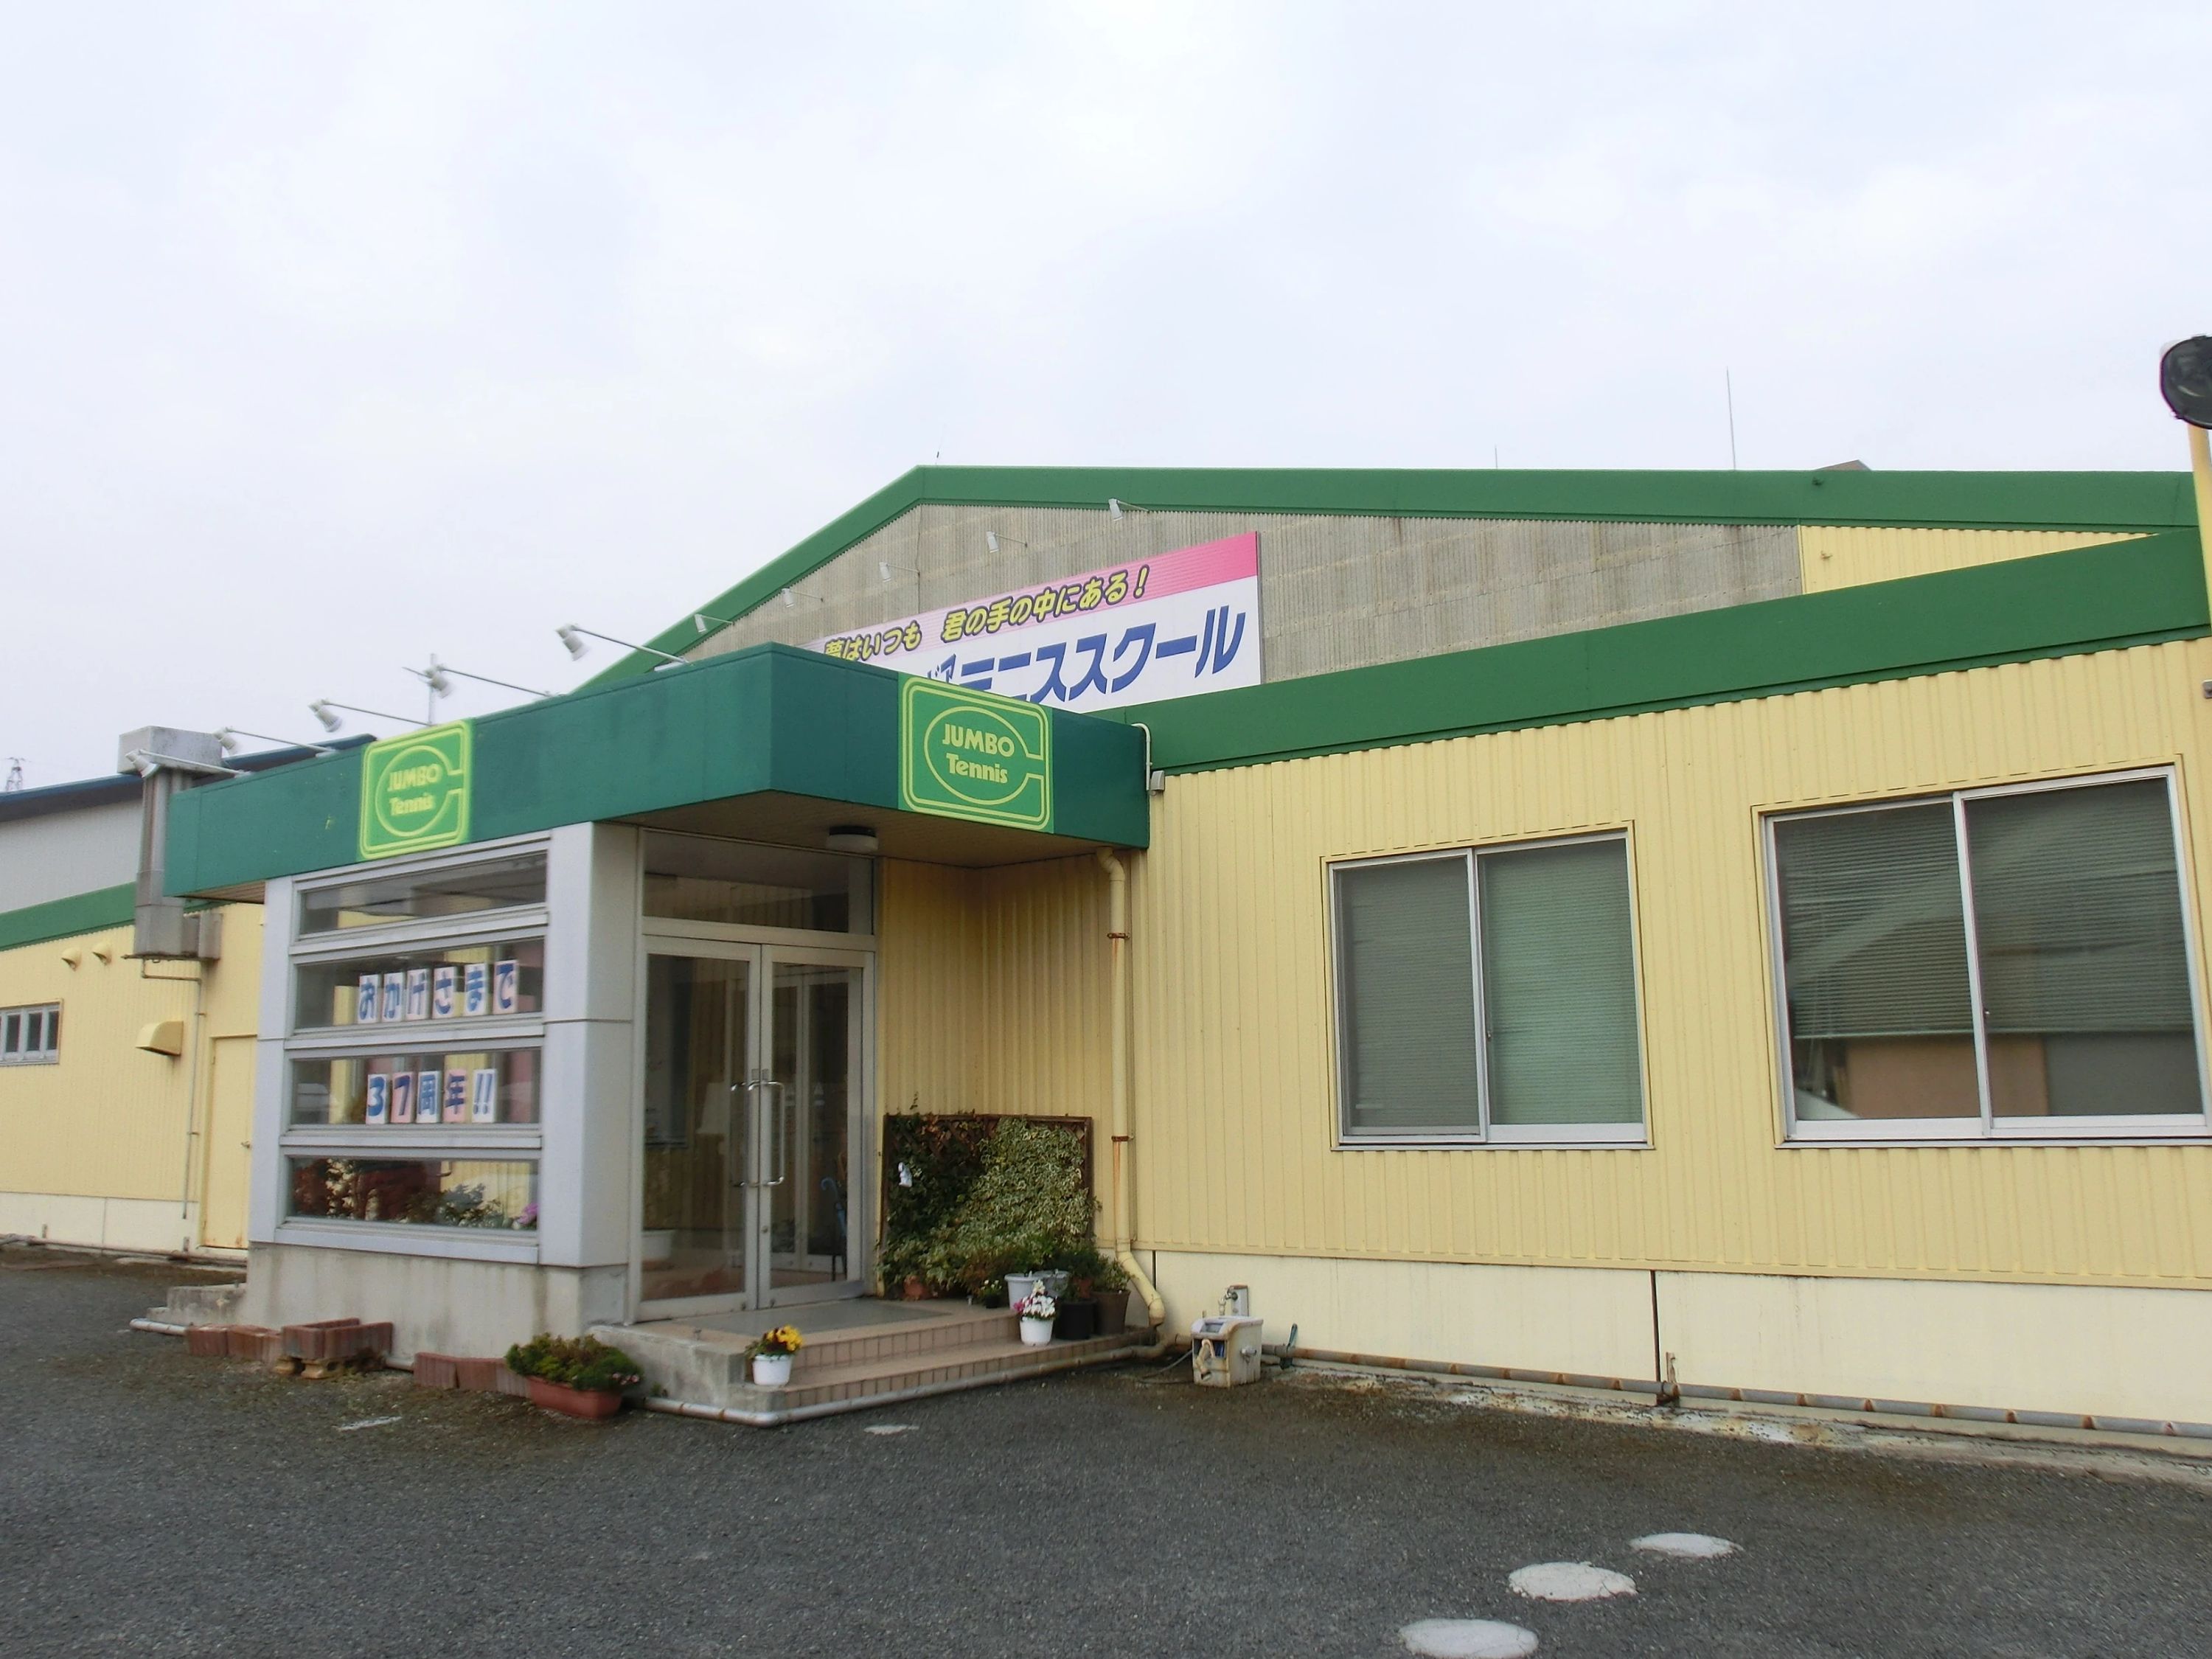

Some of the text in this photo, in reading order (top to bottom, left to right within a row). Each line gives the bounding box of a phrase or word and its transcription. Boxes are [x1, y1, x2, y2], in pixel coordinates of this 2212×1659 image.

[825, 564, 1150, 661] 夢はいつも 君の手の中にある！
[942, 723, 1015, 757] JUMBO
[387, 763, 442, 792] JUMBO
[946, 753, 1009, 784] Tennis
[389, 793, 435, 816] Tennis
[358, 963, 515, 1020] おかげさまで
[367, 1072, 494, 1117] 37周年!!
